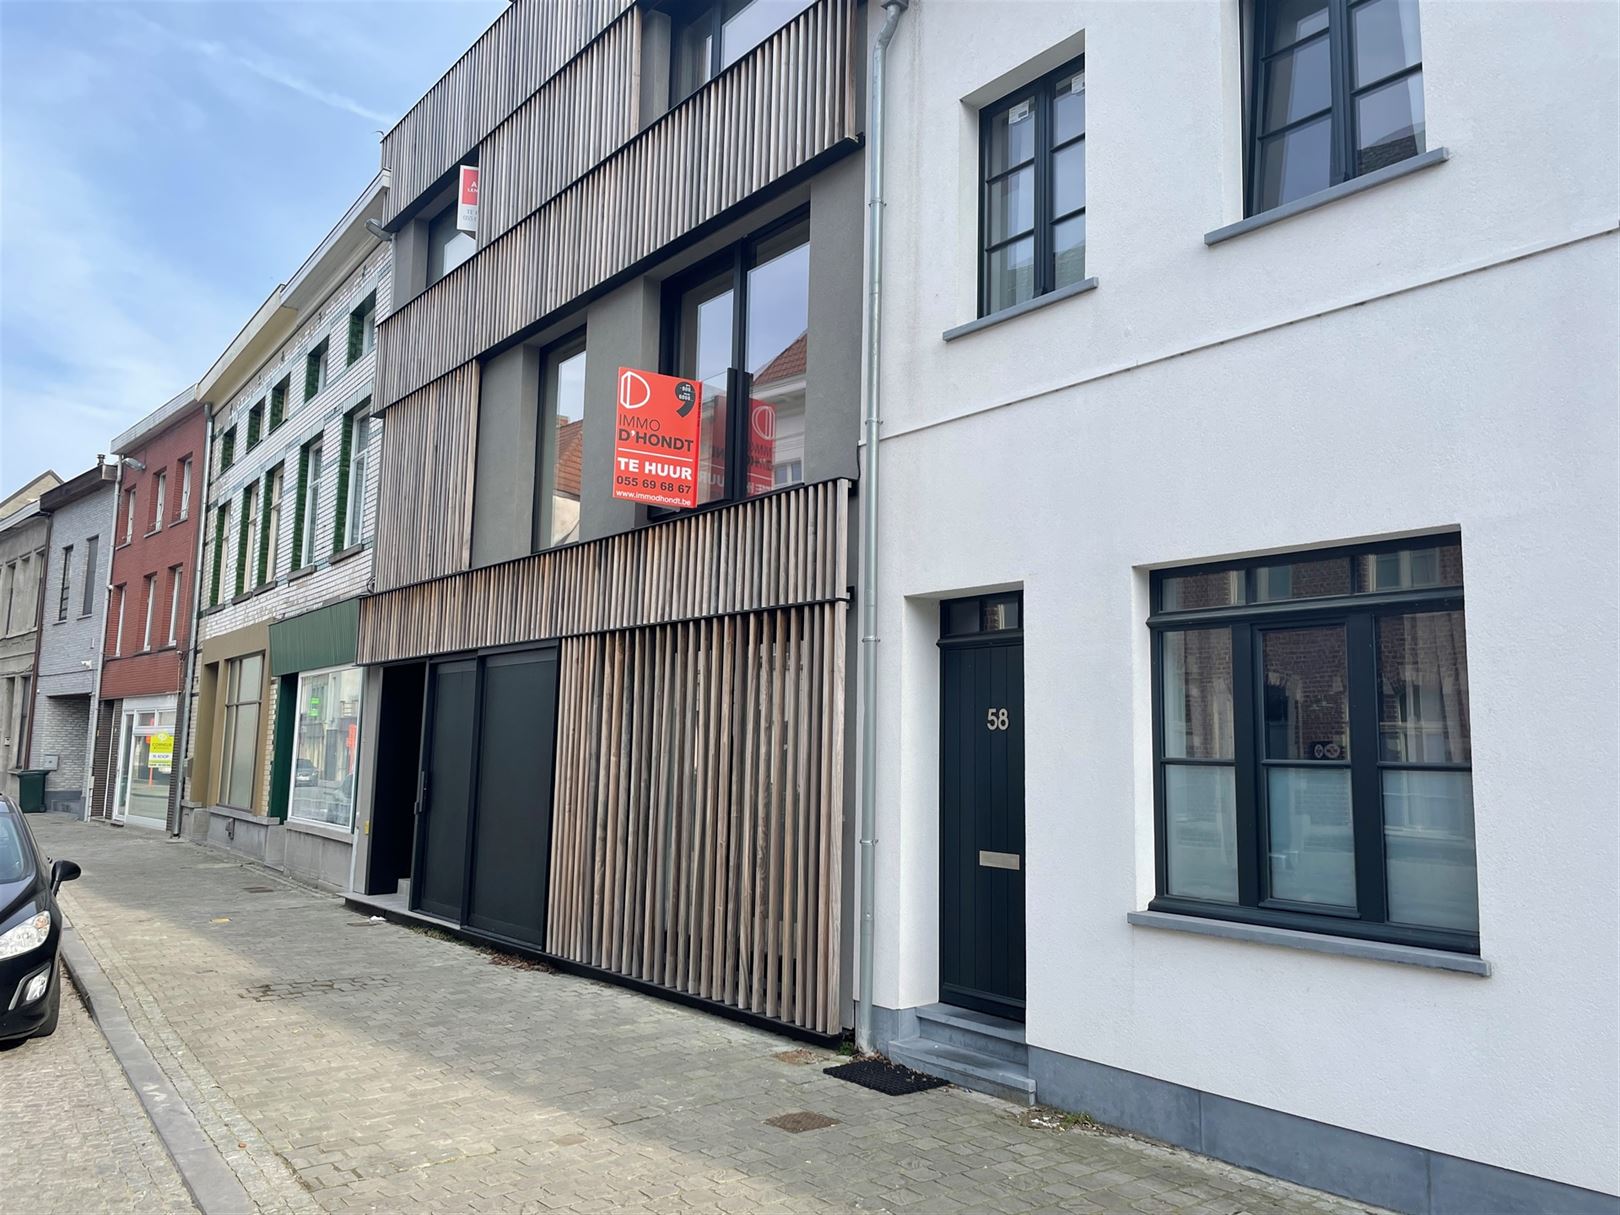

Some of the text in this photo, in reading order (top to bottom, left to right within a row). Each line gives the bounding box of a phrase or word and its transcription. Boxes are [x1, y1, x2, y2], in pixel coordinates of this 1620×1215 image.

[619, 414, 661, 432] IMMO
[618, 428, 694, 452] D'HONDT
[617, 457, 692, 480] TE HUUR
[616, 475, 691, 494] 055 69 68 67
[616, 490, 691, 506] www.immodhondt.be
[987, 708, 1009, 730] 58
